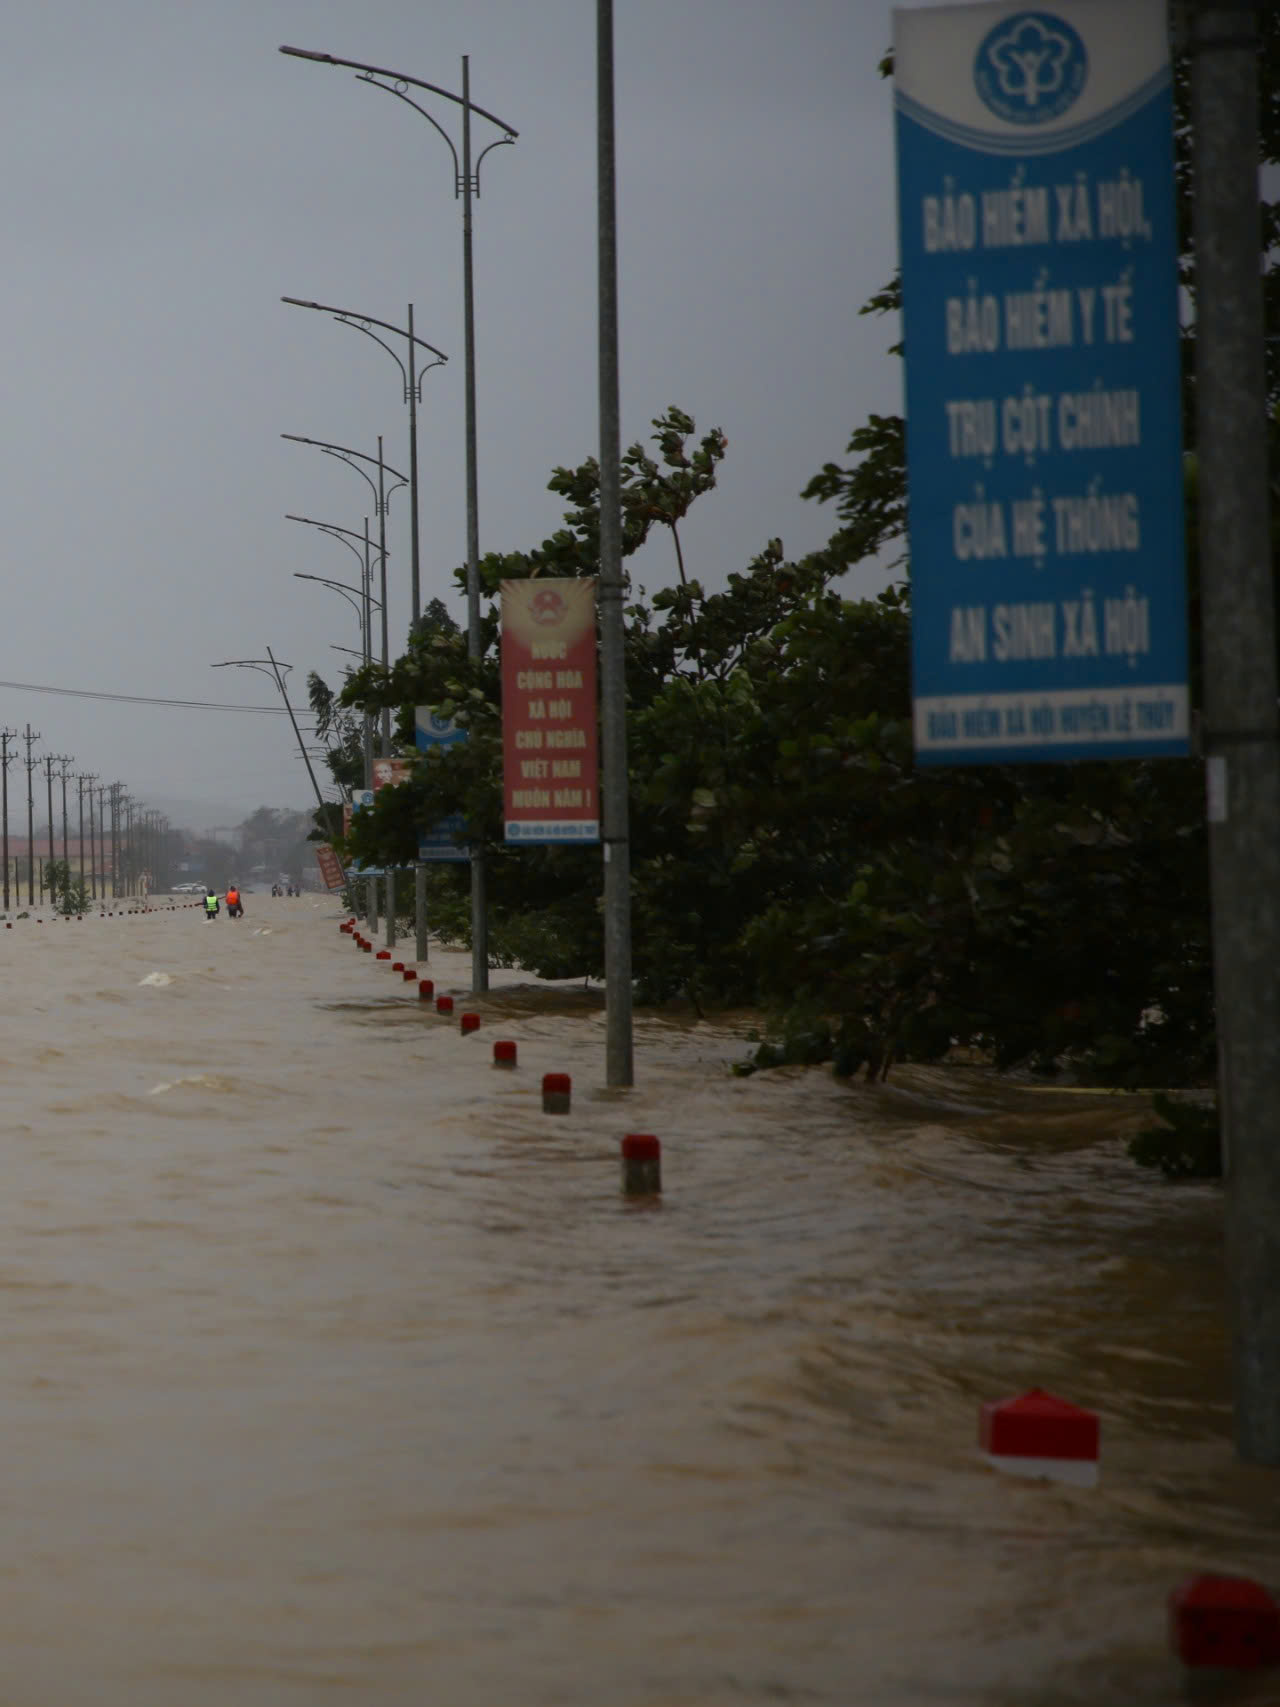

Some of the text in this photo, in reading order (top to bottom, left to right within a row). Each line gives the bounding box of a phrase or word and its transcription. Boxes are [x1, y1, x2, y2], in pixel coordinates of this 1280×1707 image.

[923, 175, 976, 252] BẢO
[981, 163, 1049, 248] HIỂM
[1055, 171, 1092, 242] XÃ
[945, 264, 1134, 354] BẢO HIỂM Y TẾ
[945, 376, 1140, 469] TRỤ CỘT CHÍNH
[953, 474, 1140, 569] CỦA HỆ THỐNG
[949, 584, 1149, 668] AN SINH XÃ HỘI
[517, 670, 553, 692] CỘNG
[528, 699, 572, 721] XÃ HỘI
[515, 729, 586, 749] CHỦ NGHĨA
[520, 758, 581, 780] VIỆT NAM
[512, 788, 550, 808] MUÔN
[554, 788, 583, 808] NĂM
